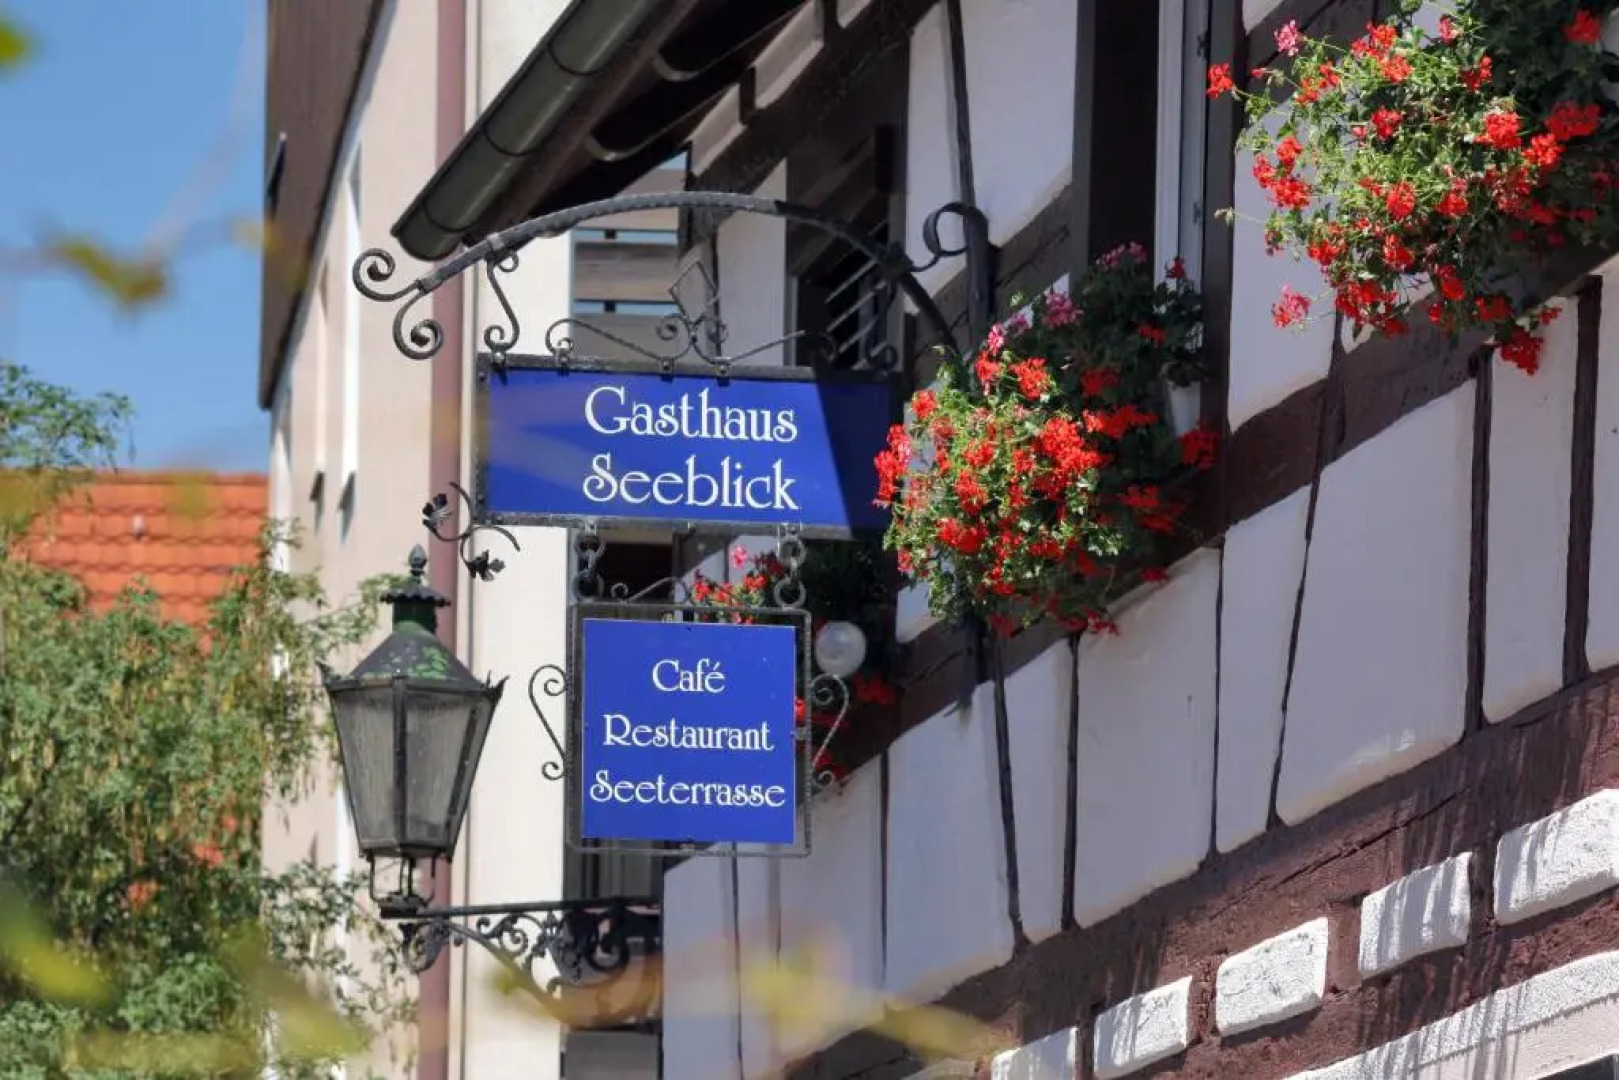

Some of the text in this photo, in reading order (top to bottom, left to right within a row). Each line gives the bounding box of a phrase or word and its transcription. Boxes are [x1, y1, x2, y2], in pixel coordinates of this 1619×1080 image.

[584, 386, 798, 443] Gasthaus
[582, 453, 799, 510] Seeblick
[652, 658, 726, 693] Café
[603, 714, 775, 751] Restaurant
[590, 769, 785, 807] Seeterrasse
